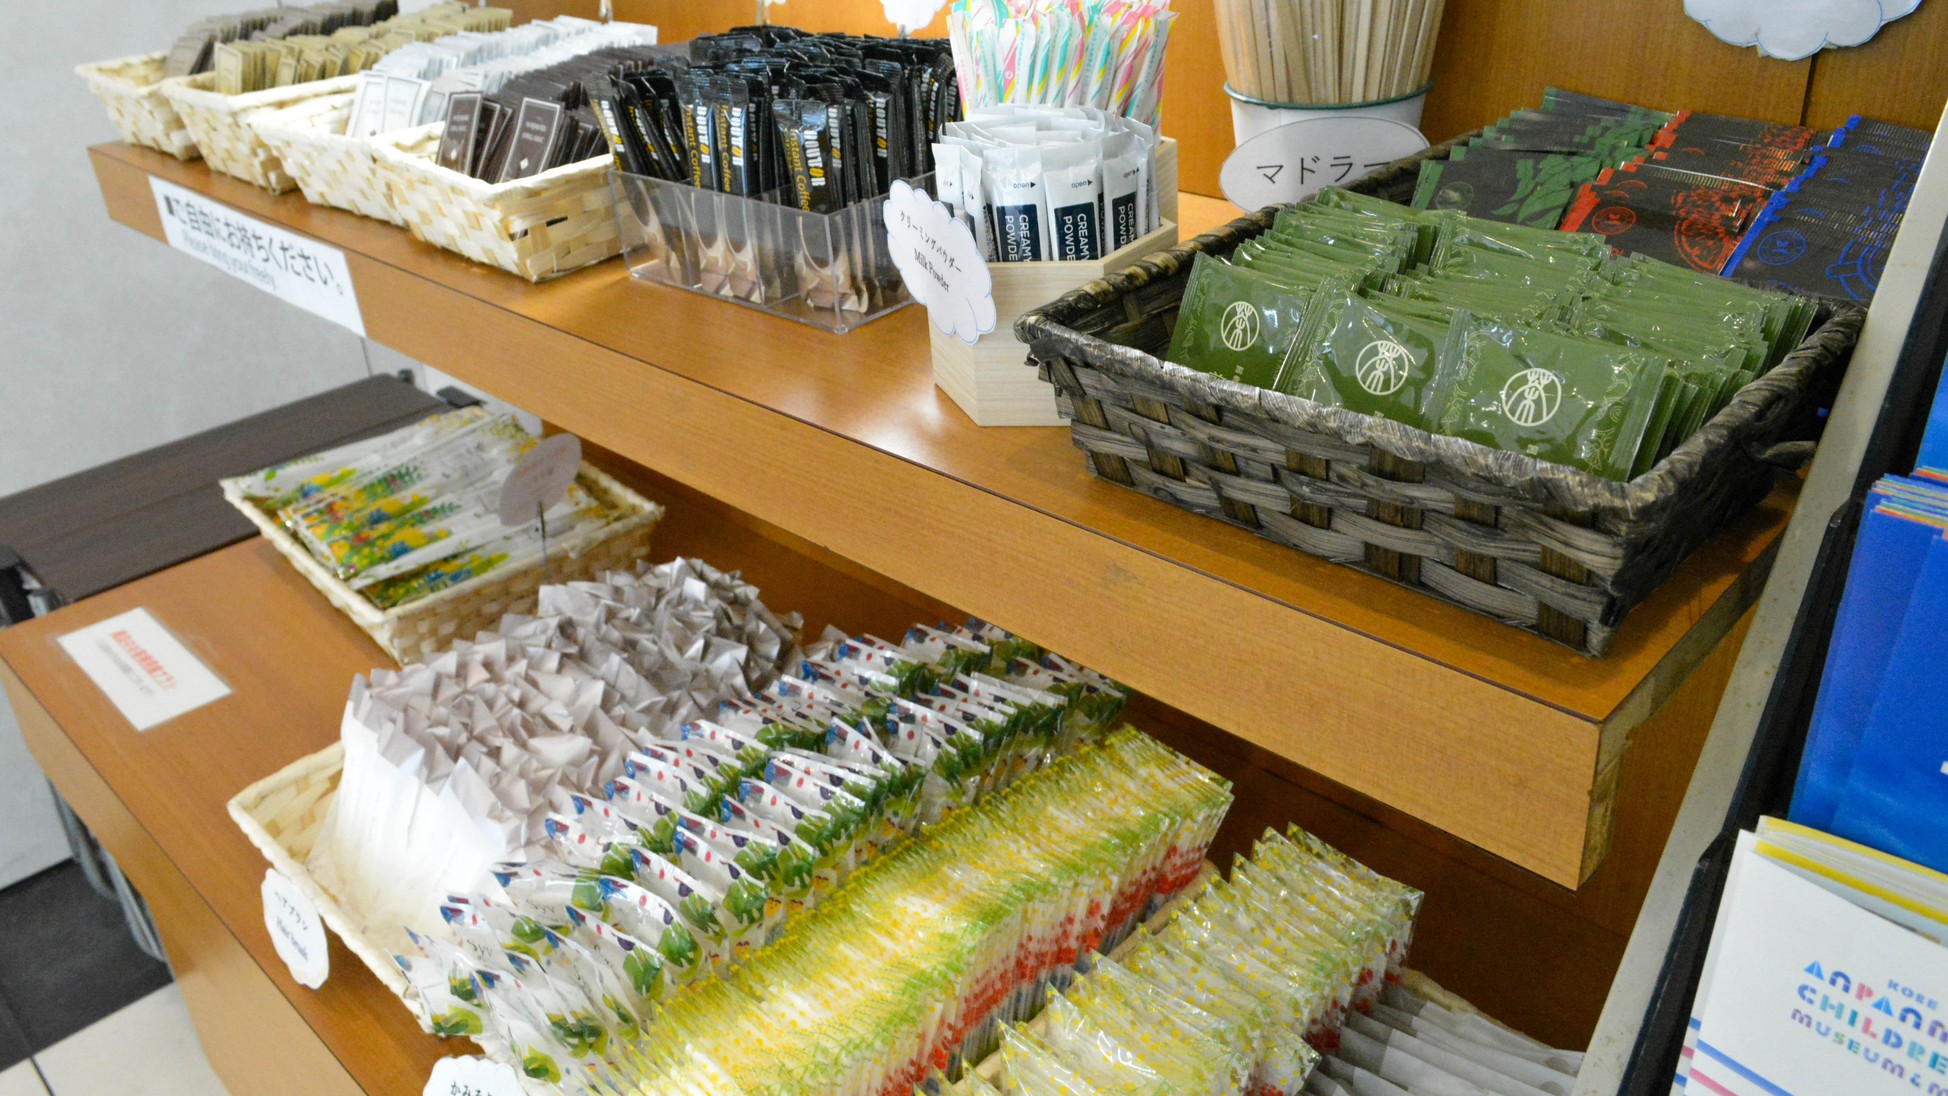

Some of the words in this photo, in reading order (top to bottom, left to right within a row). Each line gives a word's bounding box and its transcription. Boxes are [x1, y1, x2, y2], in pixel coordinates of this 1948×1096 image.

[696, 105, 711, 163] DOUTOR
[729, 106, 744, 167] DOUTOR
[790, 128, 803, 173] Instant
[721, 152, 732, 193] Coffee
[803, 130, 827, 187] DOUTOR
[1256, 155, 1391, 185] マドラー
[795, 174, 811, 212] Coffee
[900, 210, 962, 272] クリーミングパウダー
[914, 247, 929, 272] Milk
[928, 261, 950, 292] Powder
[1887, 979, 1939, 1012] KOBE
[1791, 1008, 1905, 1079] MUSEUM
